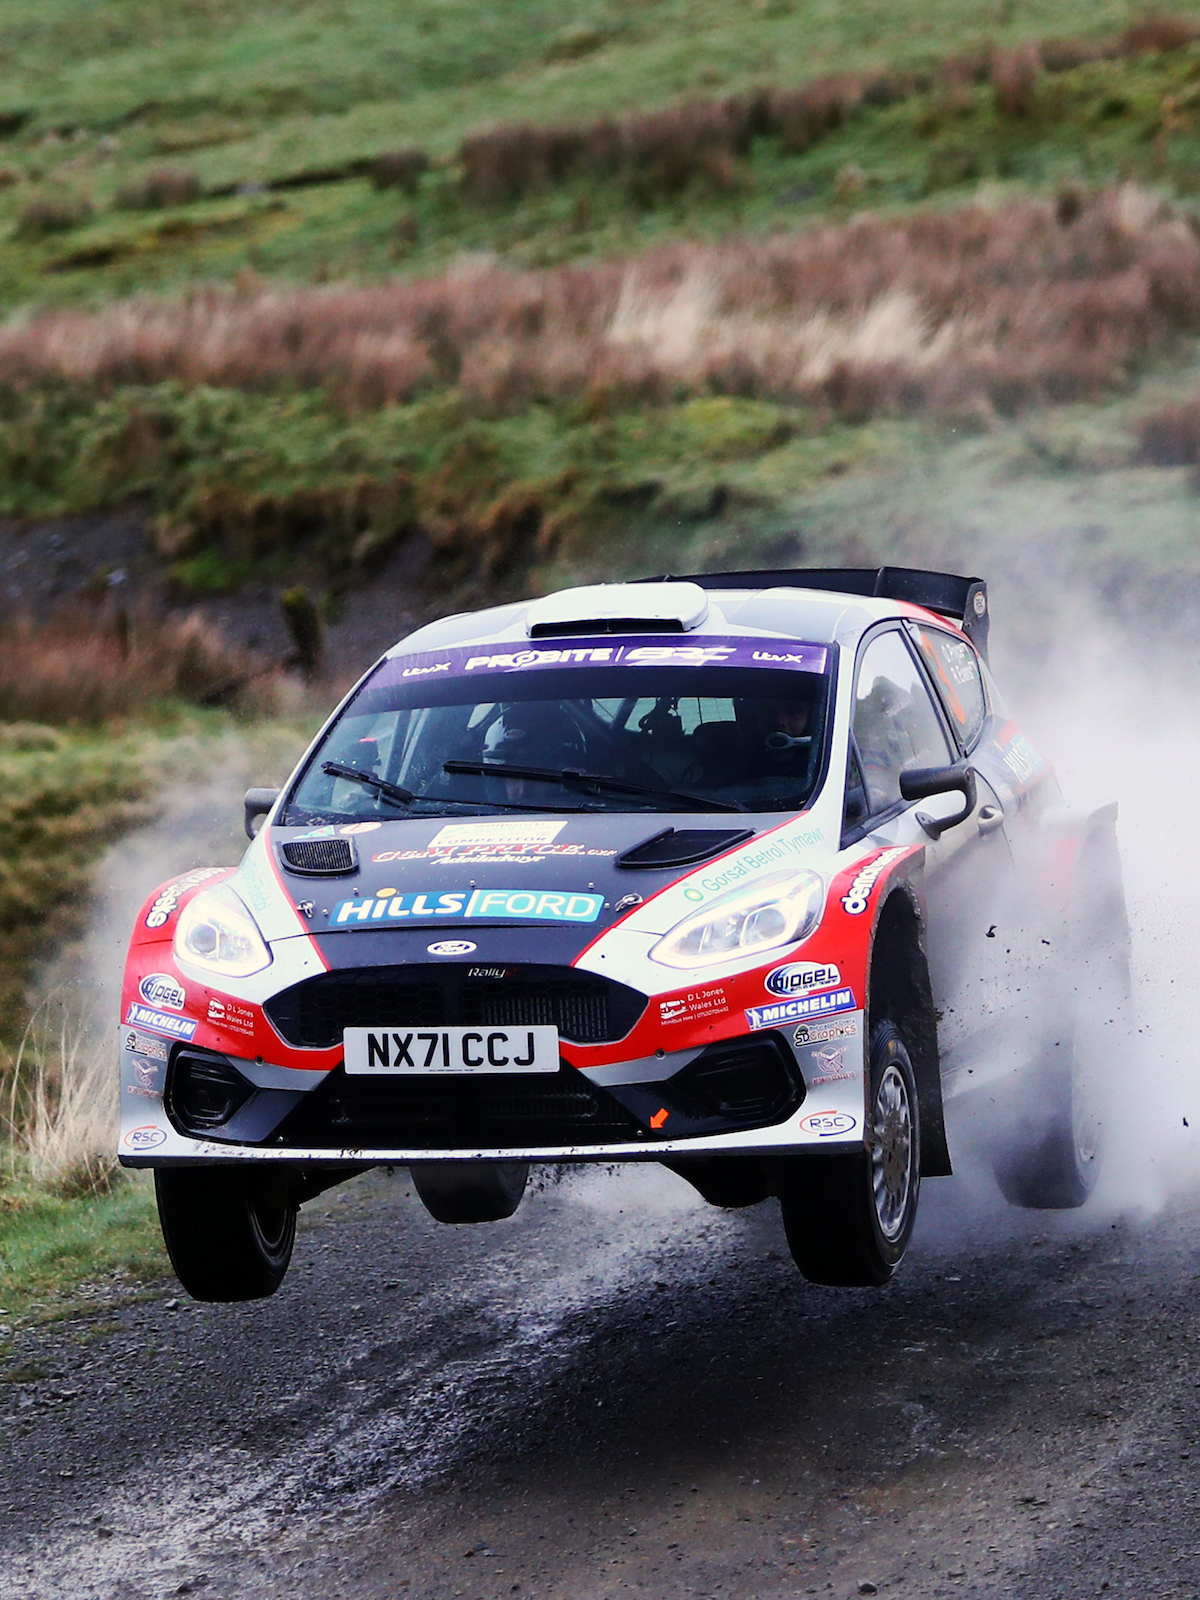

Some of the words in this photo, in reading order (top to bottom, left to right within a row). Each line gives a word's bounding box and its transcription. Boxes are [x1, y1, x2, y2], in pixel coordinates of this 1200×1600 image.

[464, 648, 614, 671] PROBITE
[701, 860, 751, 891] Gorsaf
[743, 843, 785, 869] Betrol
[777, 828, 824, 854] Tymawr
[480, 893, 596, 918] FORD
[689, 1001, 712, 1011] Wales
[713, 997, 727, 1006] Ltd
[702, 988, 724, 998] Jones
[762, 990, 851, 1021] MICHELIN
[136, 1009, 196, 1035] MICHELIN
[367, 1033, 450, 1067] NX71
[462, 1032, 535, 1066] CCJ
[810, 1116, 844, 1128] RSC
[132, 1132, 159, 1142] RSC
